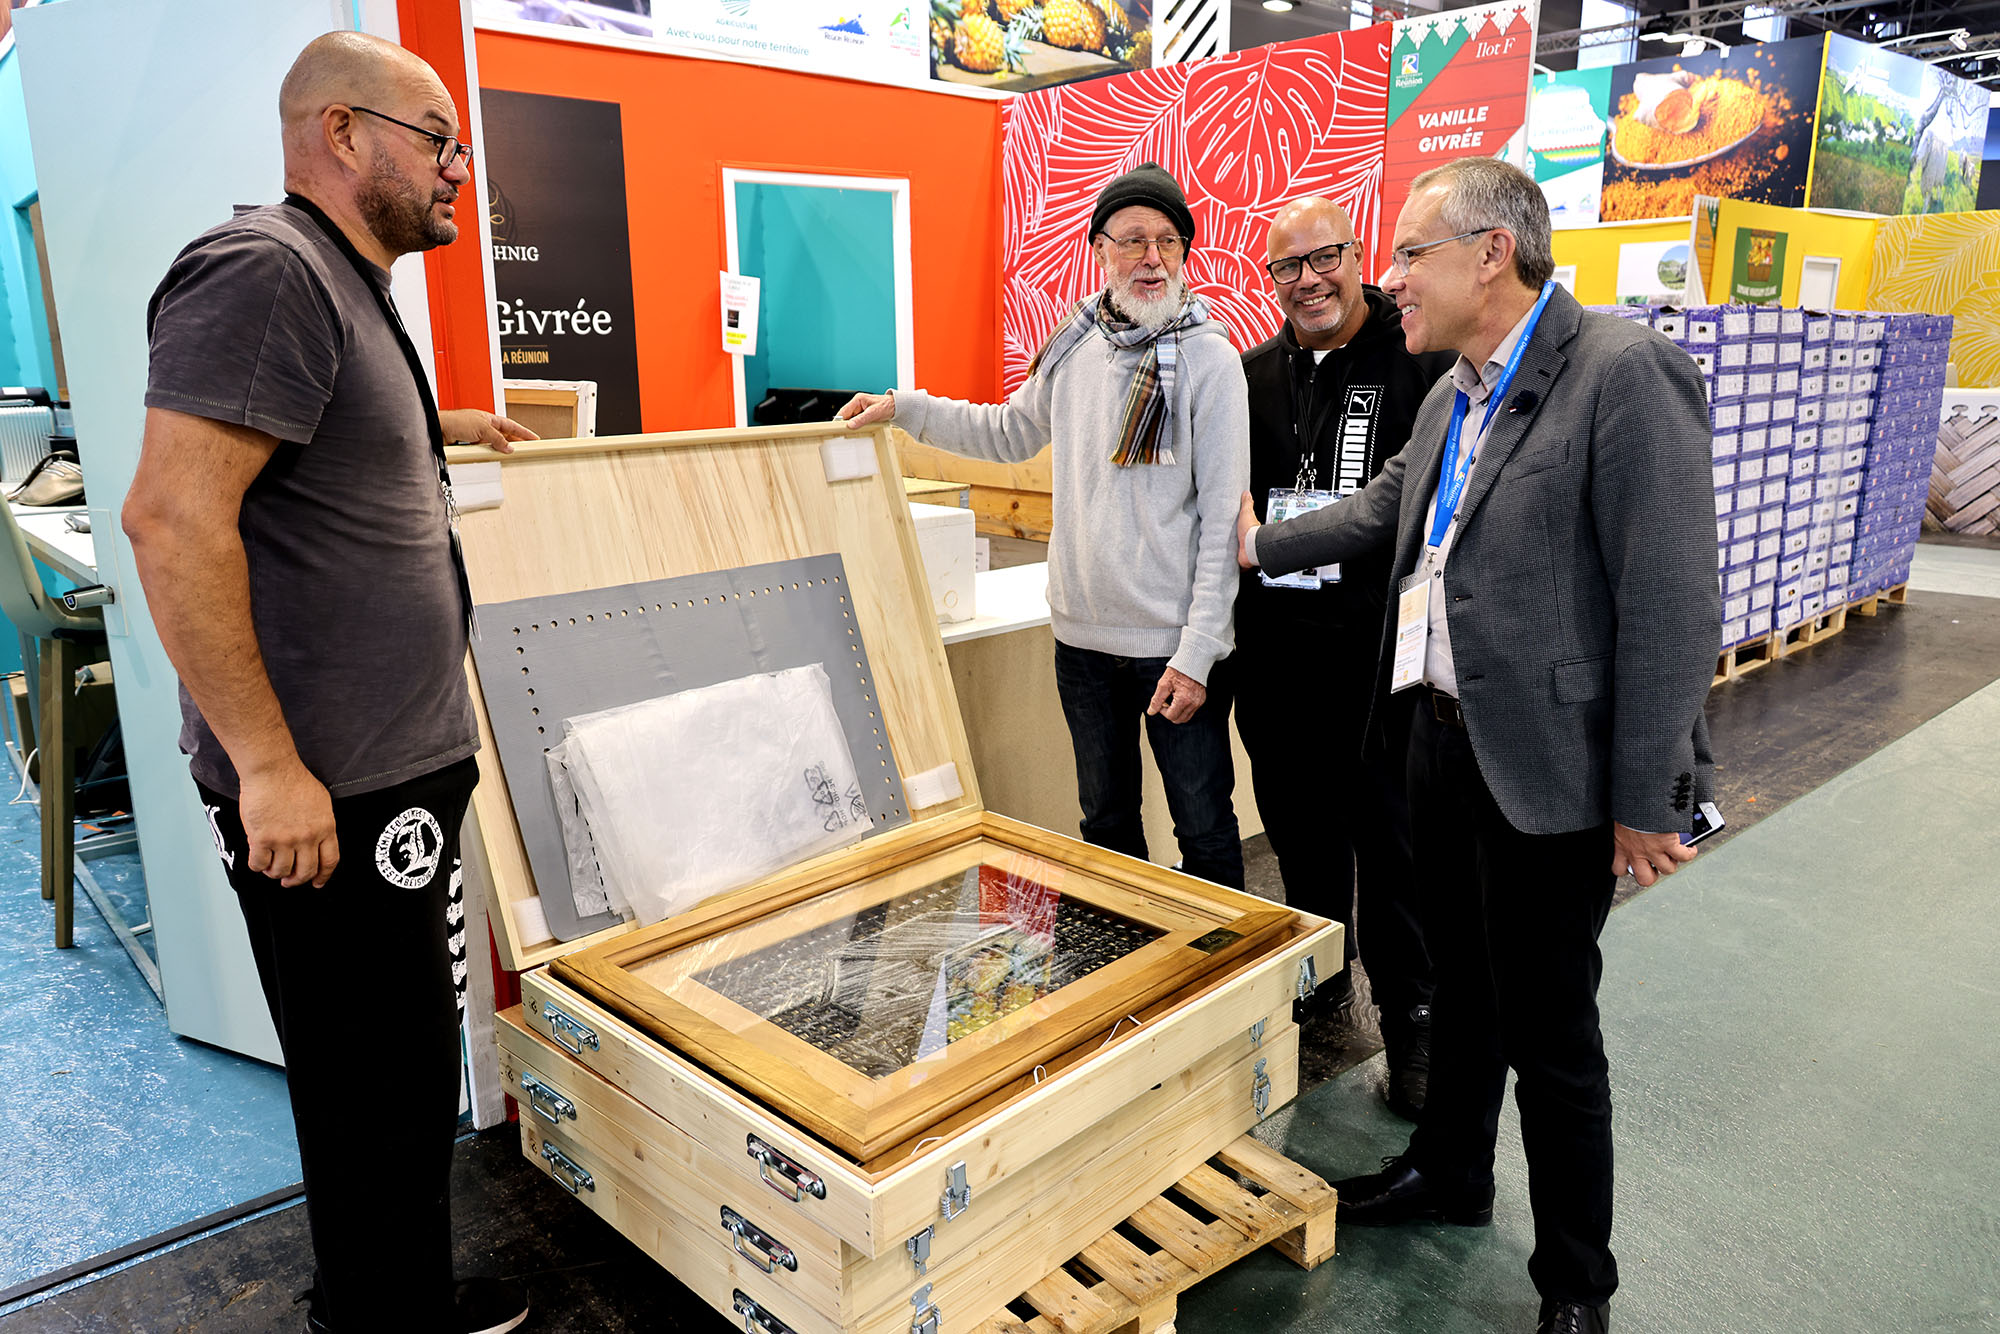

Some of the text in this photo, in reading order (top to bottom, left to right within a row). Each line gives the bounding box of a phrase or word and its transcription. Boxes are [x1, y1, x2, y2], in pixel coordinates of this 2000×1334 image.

[716, 18, 758, 31] AGRICULTURE
[666, 27, 810, 56] Avec vous pour notre territoire
[1503, 37, 1516, 54] F
[1418, 106, 1489, 129] VANILLE
[1418, 126, 1484, 153] GIVRÉE
[493, 245, 540, 262] HNIG
[496, 298, 612, 336] Givrée
[502, 348, 549, 364] A RÉUNION
[1339, 415, 1370, 495] PUMA
[379, 819, 402, 856] LIMITED
